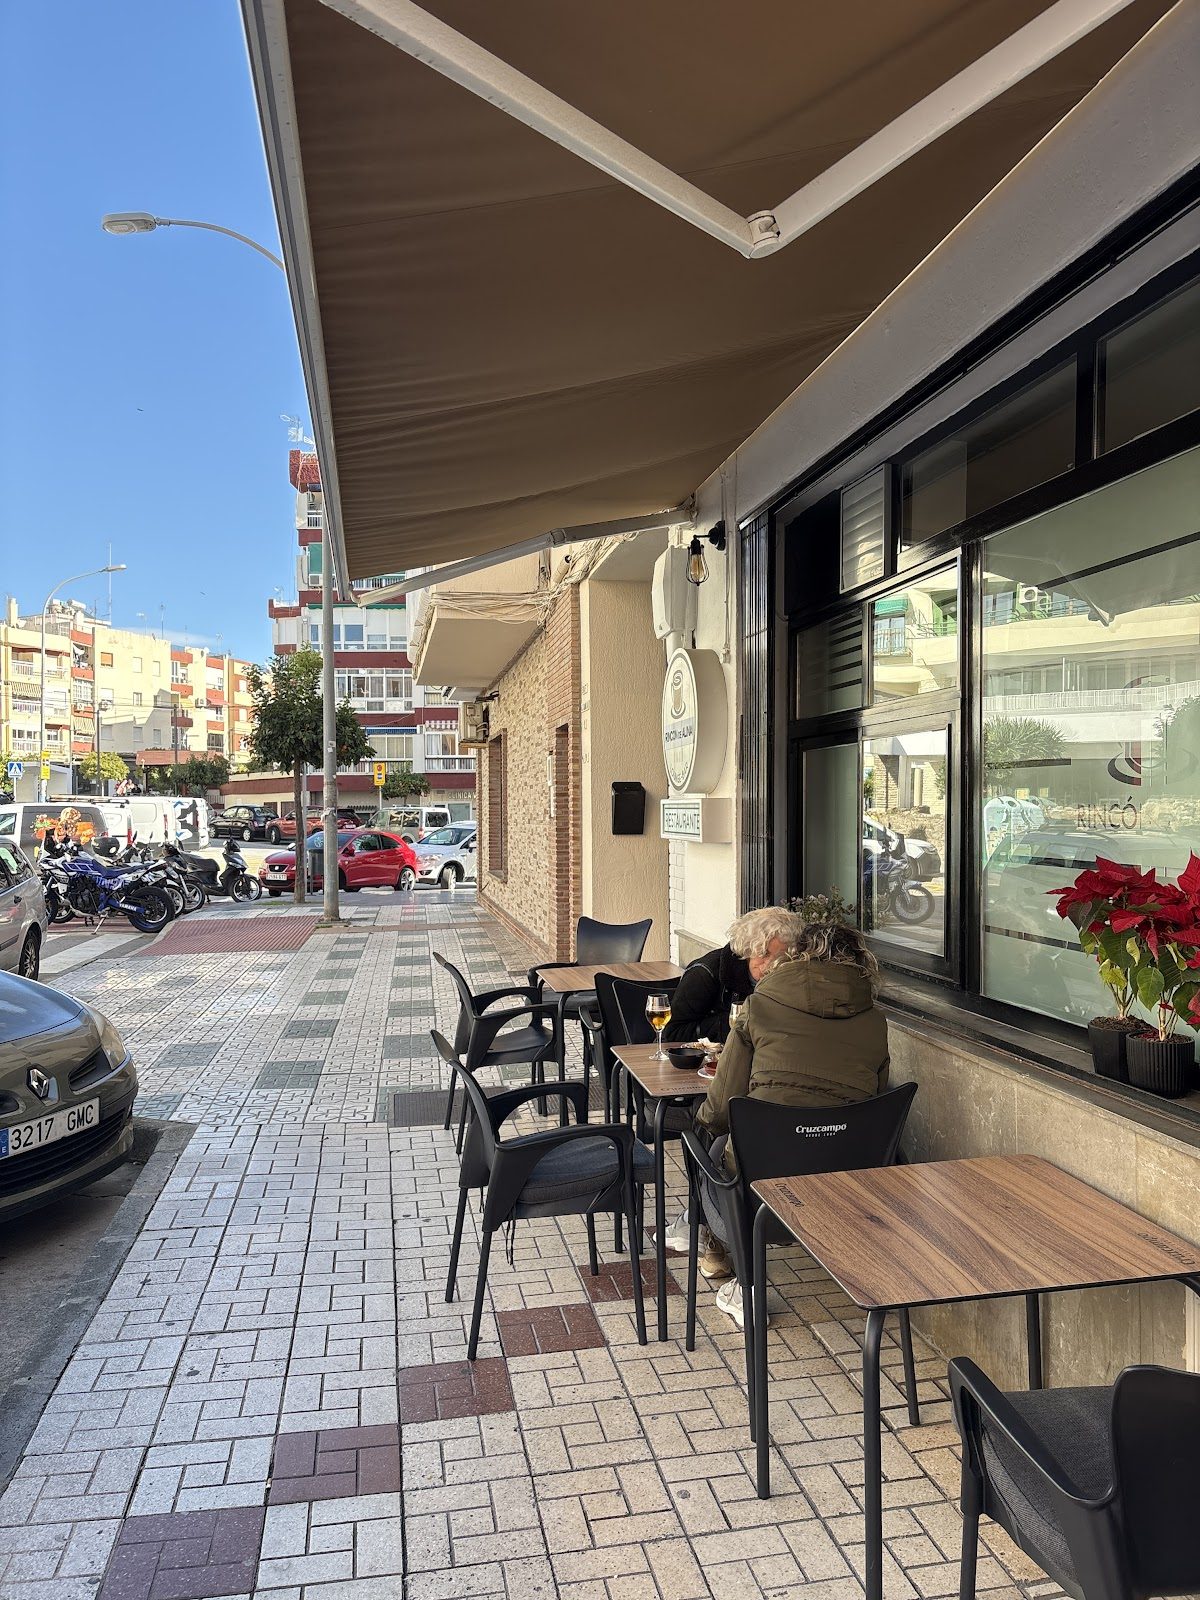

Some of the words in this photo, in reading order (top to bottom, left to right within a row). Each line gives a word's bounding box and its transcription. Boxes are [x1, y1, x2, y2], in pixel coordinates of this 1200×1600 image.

[665, 812, 699, 830] RESTAURANTE
[120, 903, 137, 911] YAMAHA
[11, 1117, 54, 1150] 3217
[67, 1105, 93, 1131] GMC
[795, 1123, 847, 1133] Cruzcampo
